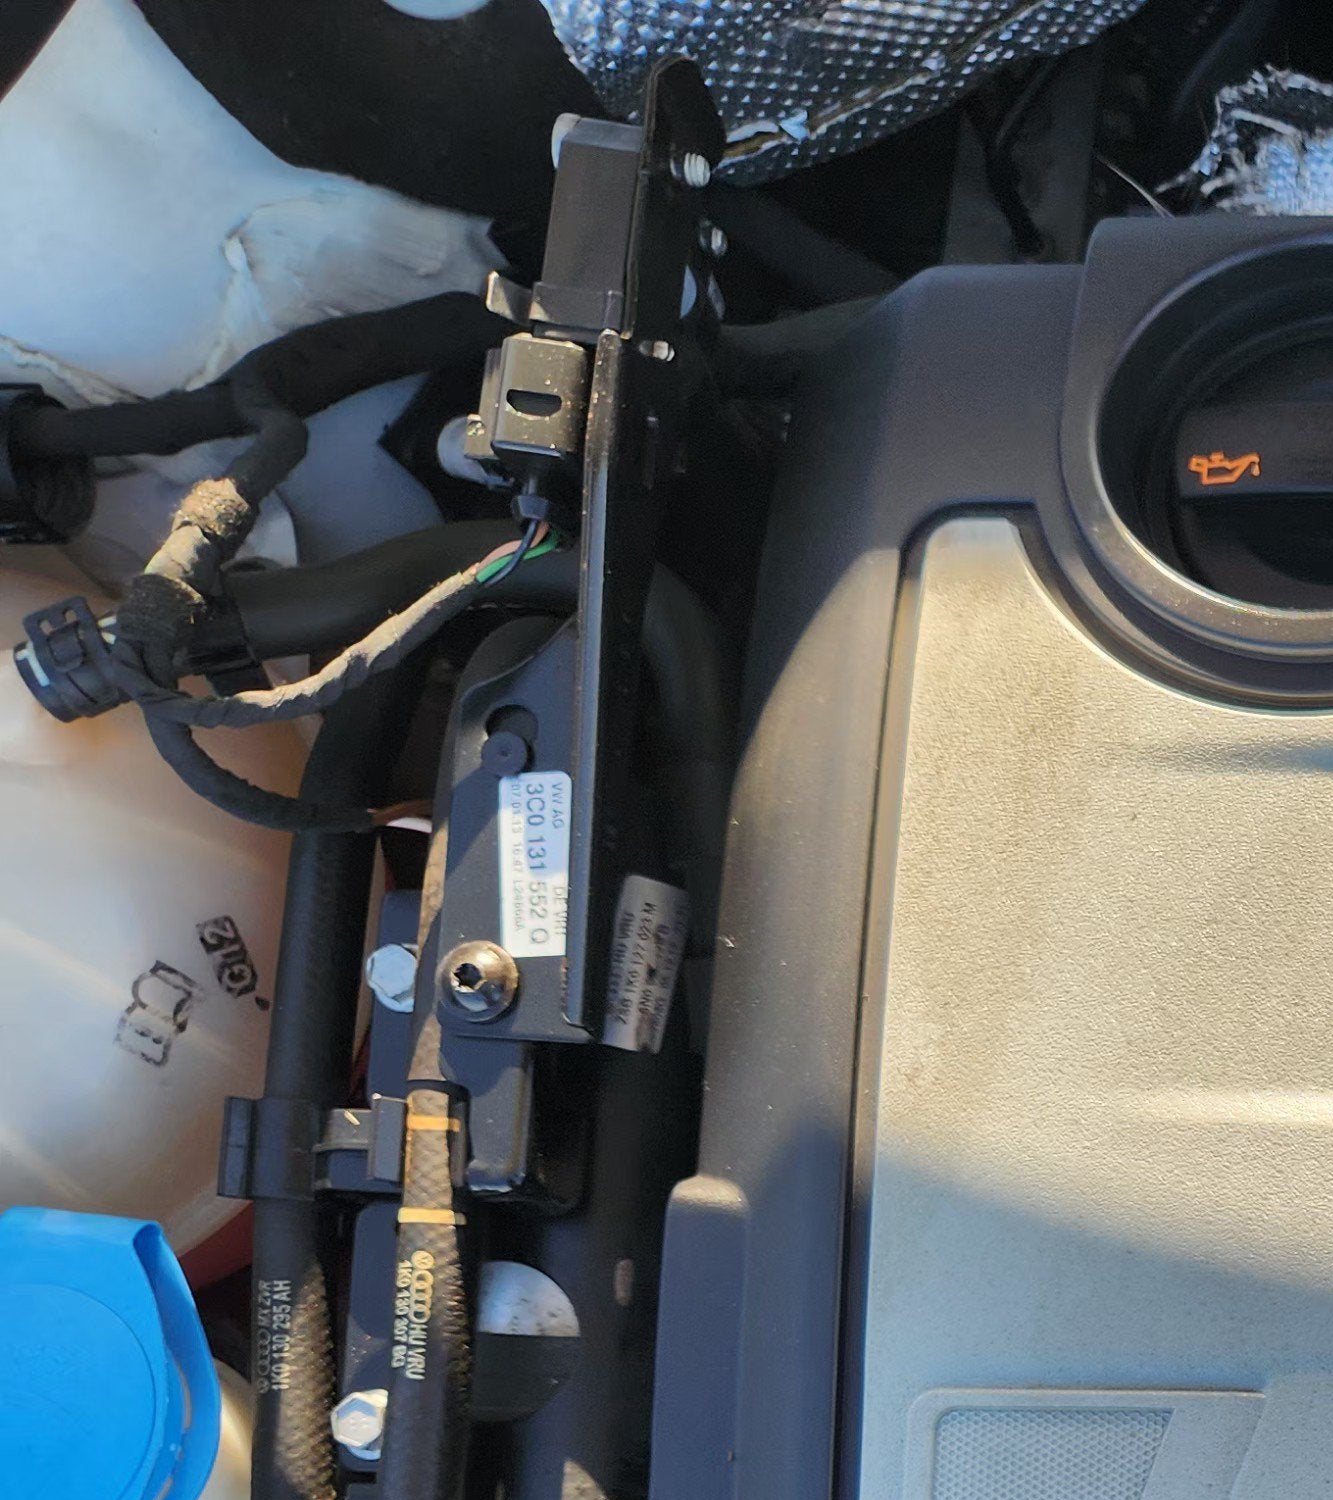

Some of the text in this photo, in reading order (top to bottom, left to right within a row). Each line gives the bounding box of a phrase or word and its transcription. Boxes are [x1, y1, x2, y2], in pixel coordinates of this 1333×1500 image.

[551, 782, 565, 804] VW
[525, 782, 550, 944] 3C0 131 552 Q
[271, 1279, 293, 1391] 1K0 130 295 AH
[407, 1323, 428, 1345] HU
[405, 1347, 427, 1380] VRU
